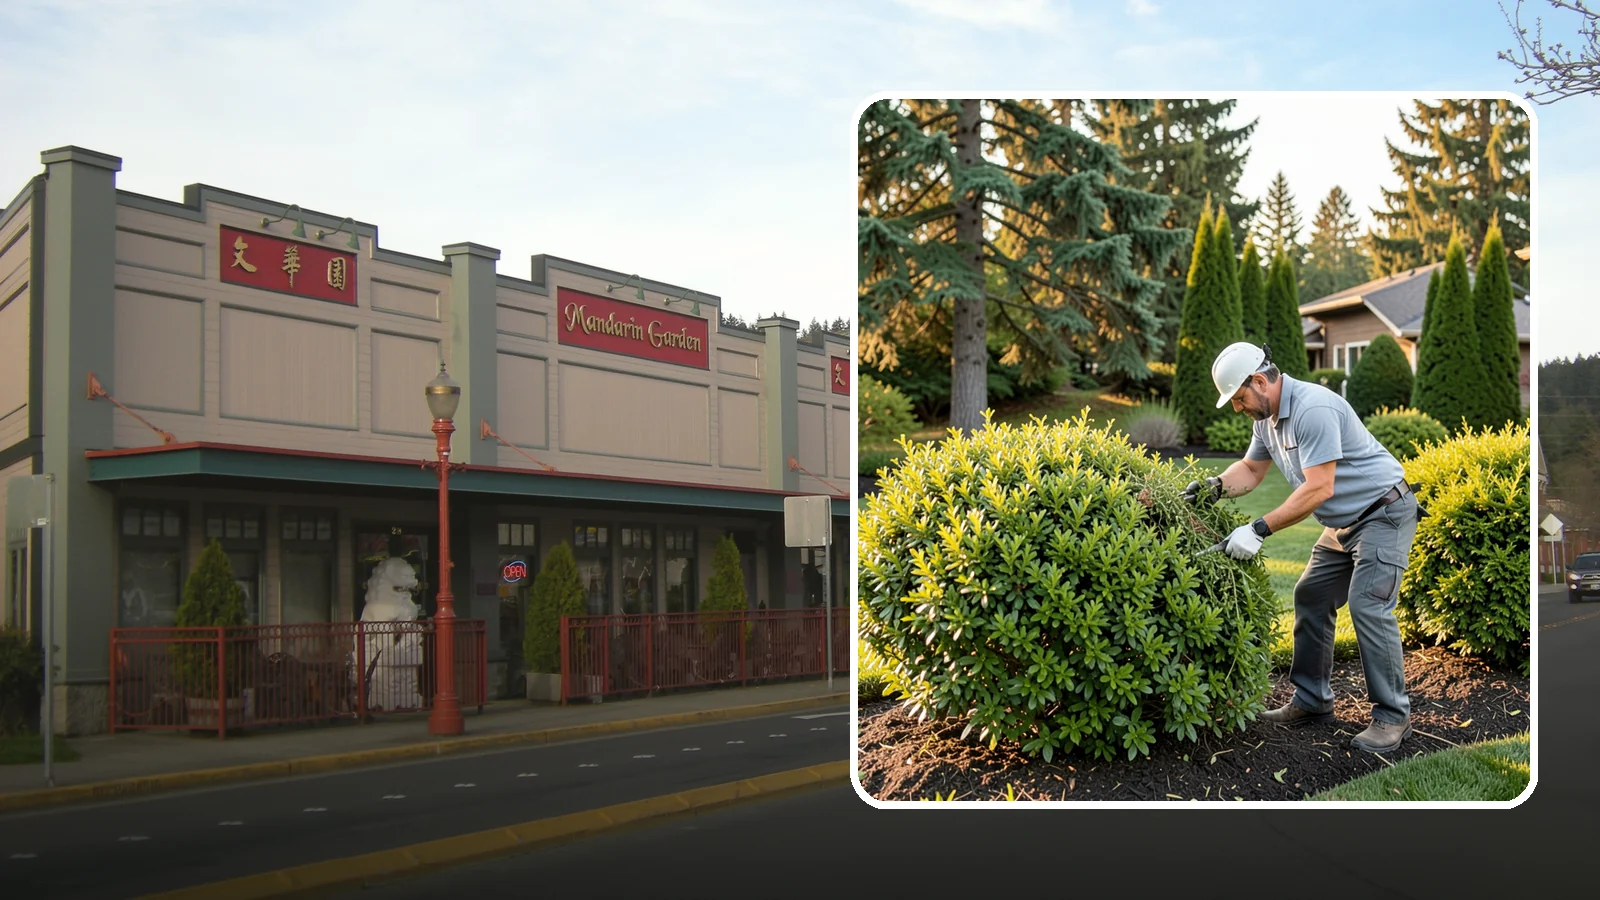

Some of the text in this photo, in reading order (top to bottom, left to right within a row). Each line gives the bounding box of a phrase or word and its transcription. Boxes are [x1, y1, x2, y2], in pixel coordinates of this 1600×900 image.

[231, 235, 346, 291] 文華園
[564, 302, 702, 352] Mandarin Garden
[503, 565, 527, 578] OPEN
